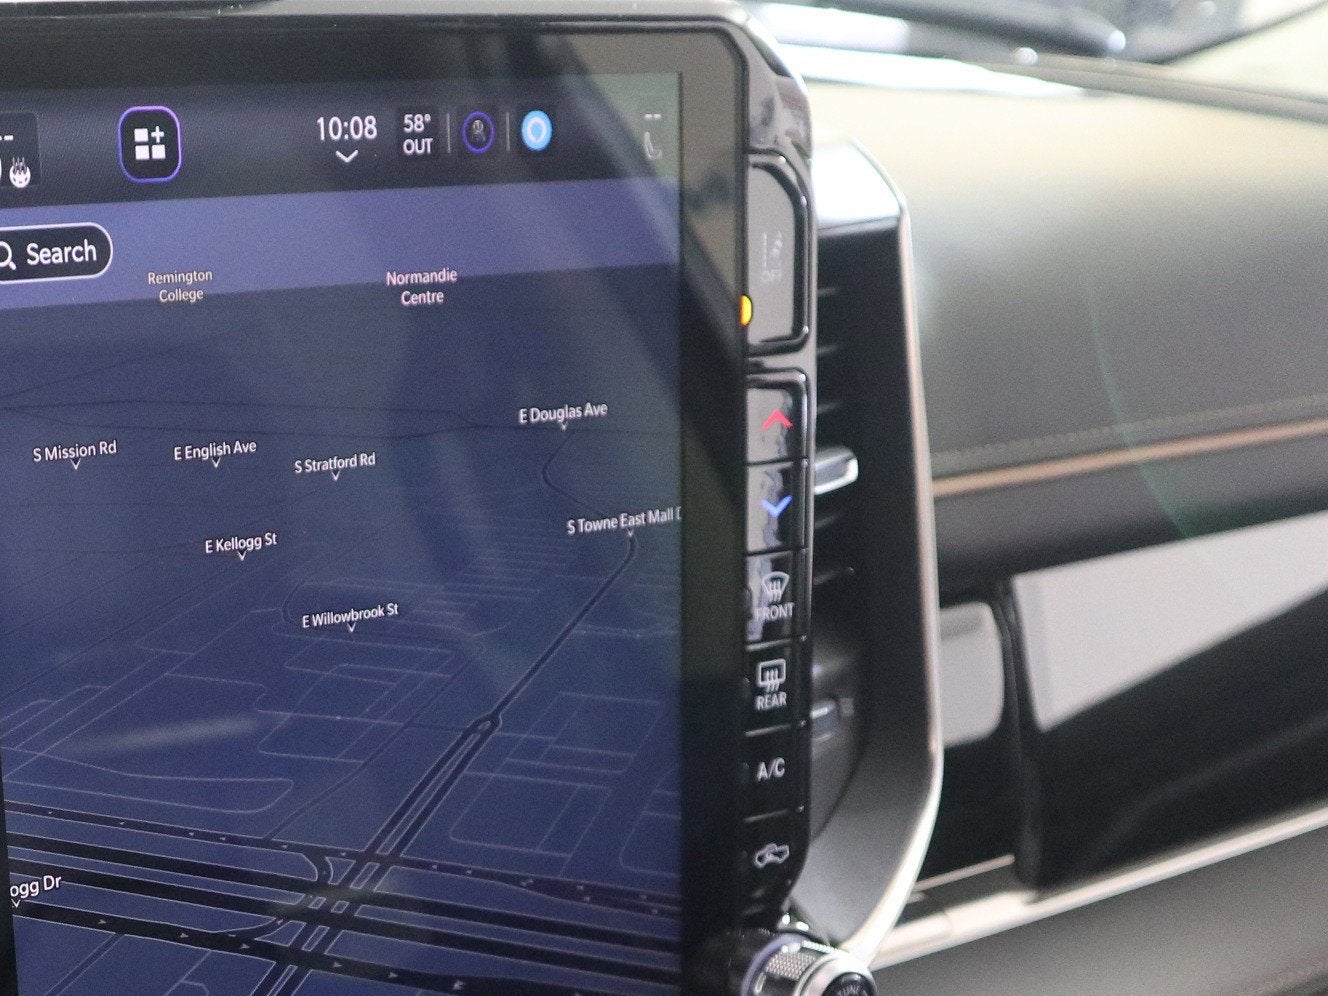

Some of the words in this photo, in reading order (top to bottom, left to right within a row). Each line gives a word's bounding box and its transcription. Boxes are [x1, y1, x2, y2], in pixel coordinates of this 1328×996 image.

[317, 115, 377, 141] 10:08
[403, 113, 431, 133] 58°
[403, 138, 433, 155] OUT
[26, 238, 97, 265] Search
[147, 268, 213, 287] Remington
[385, 267, 458, 287] Normandie
[158, 285, 204, 304] College
[401, 286, 445, 306] Centre
[519, 409, 527, 424] E
[530, 404, 582, 424] Douglas
[584, 402, 608, 417] Ave
[33, 447, 41, 462] S
[45, 443, 95, 461] Mission
[99, 440, 117, 454] Rd
[174, 446, 182, 461] E
[185, 441, 230, 460] English
[233, 441, 257, 455] Ave
[294, 459, 302, 473] S
[304, 455, 357, 472] Stratford
[360, 451, 376, 467] Rd
[567, 519, 575, 535] S
[578, 517, 618, 533] Towne
[620, 512, 646, 528] East
[648, 507, 674, 524] Mall
[205, 540, 213, 553] E
[216, 536, 262, 552] Kellogg
[265, 532, 278, 546] St
[302, 614, 310, 628] E
[312, 604, 385, 627] Willowbrook
[387, 602, 400, 616] St
[753, 602, 794, 622] FRONT
[756, 691, 787, 711] REAR
[757, 757, 785, 781] A/C
[43, 875, 62, 891] Dr
